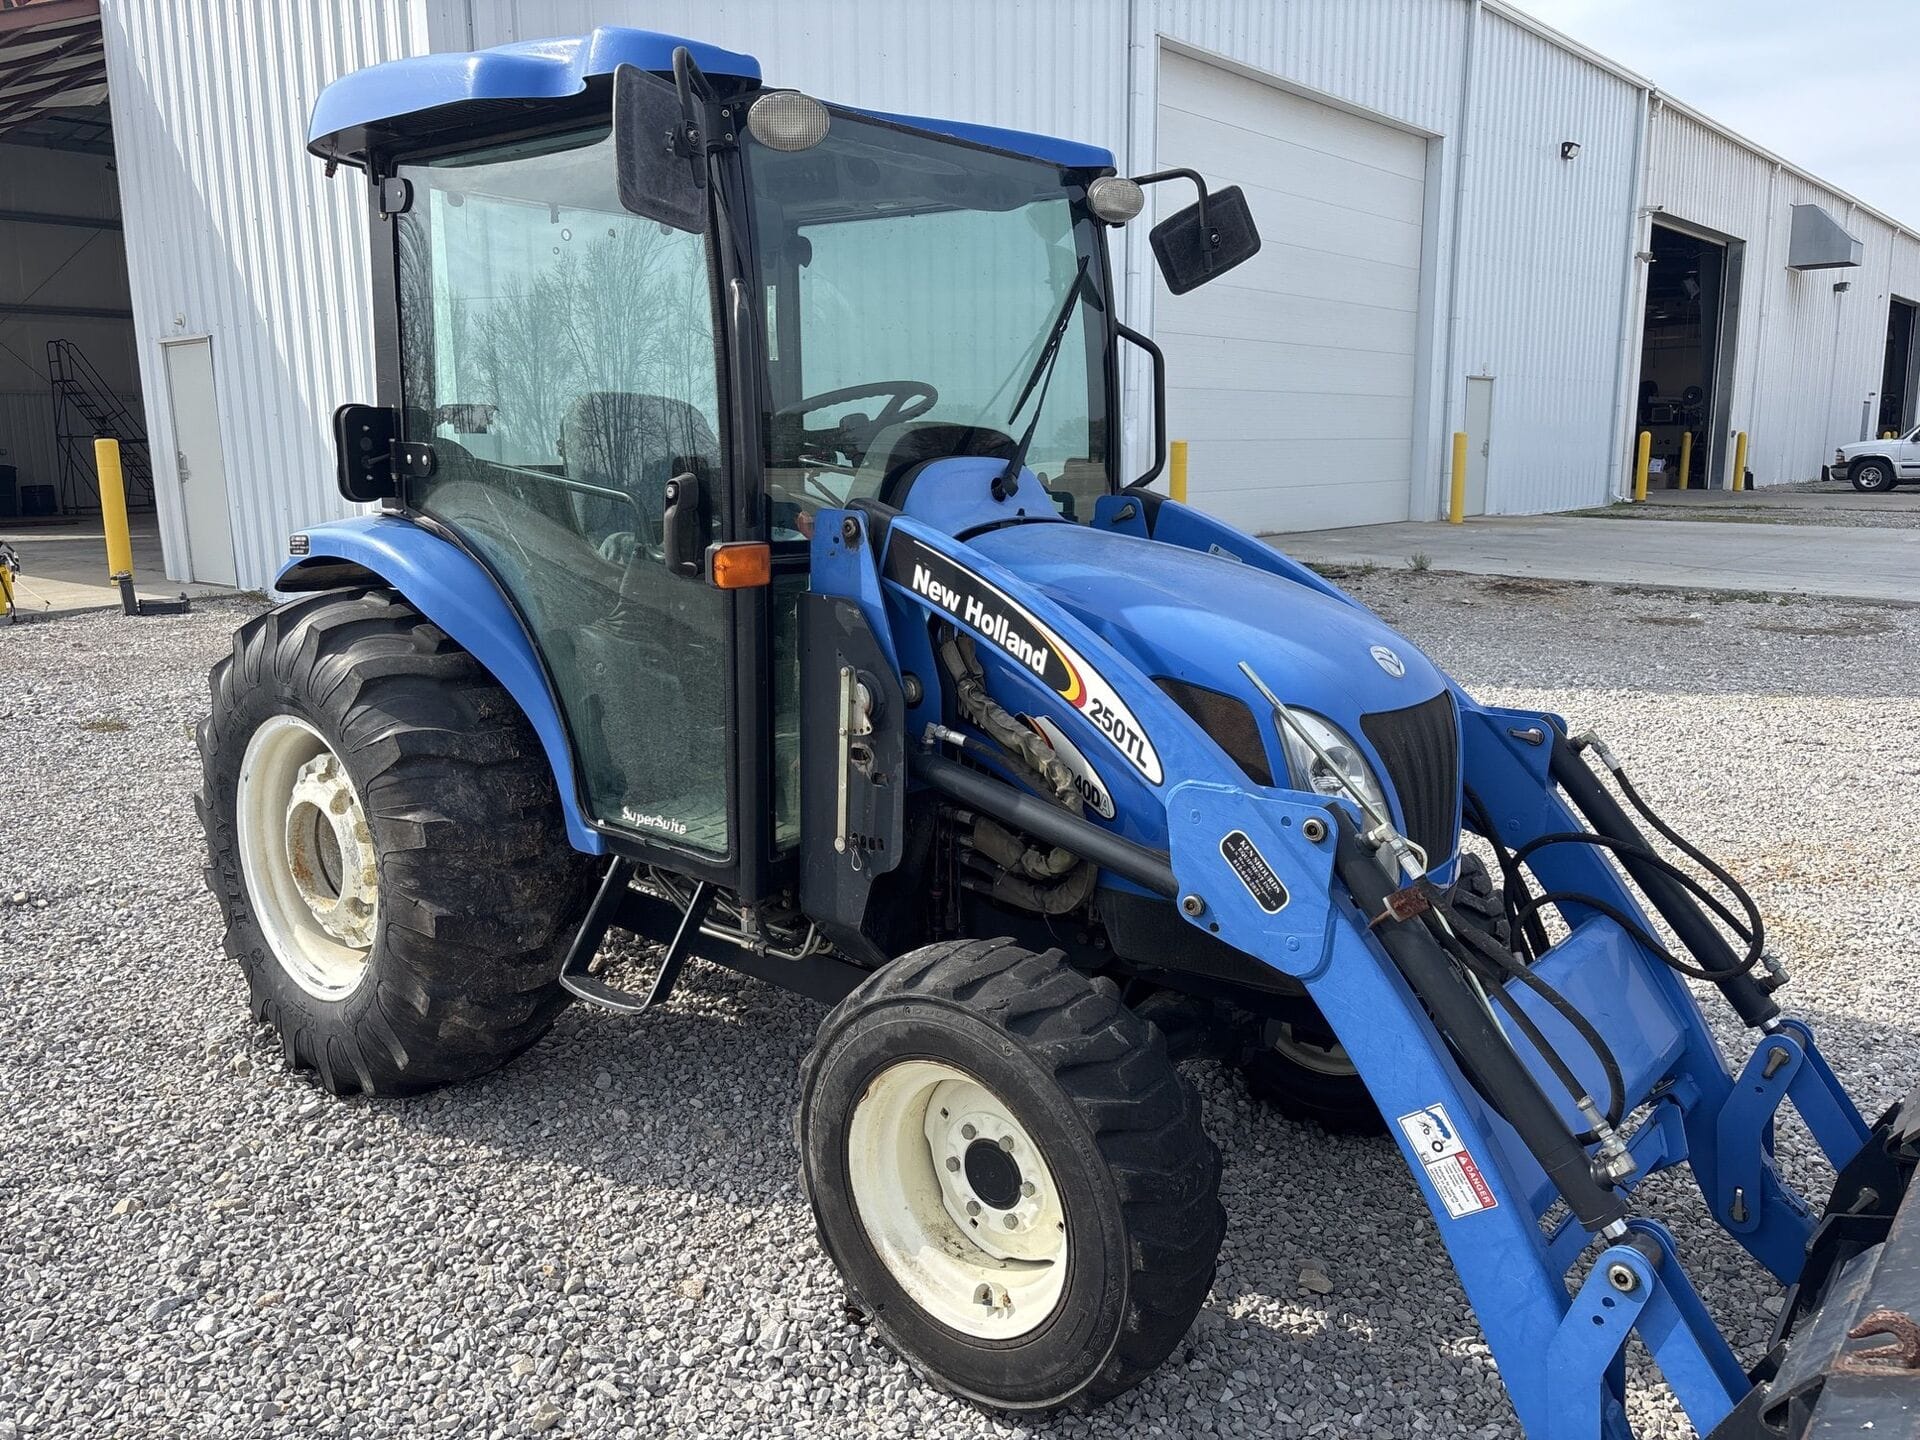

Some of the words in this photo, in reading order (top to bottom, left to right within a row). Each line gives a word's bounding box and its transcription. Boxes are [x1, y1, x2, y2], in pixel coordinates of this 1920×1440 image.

[911, 563, 961, 613] New
[964, 595, 1048, 676] Holland
[1088, 697, 1147, 769] 250TL
[622, 805, 687, 835] SuperSuite
[1465, 1165, 1491, 1204] DANGER
